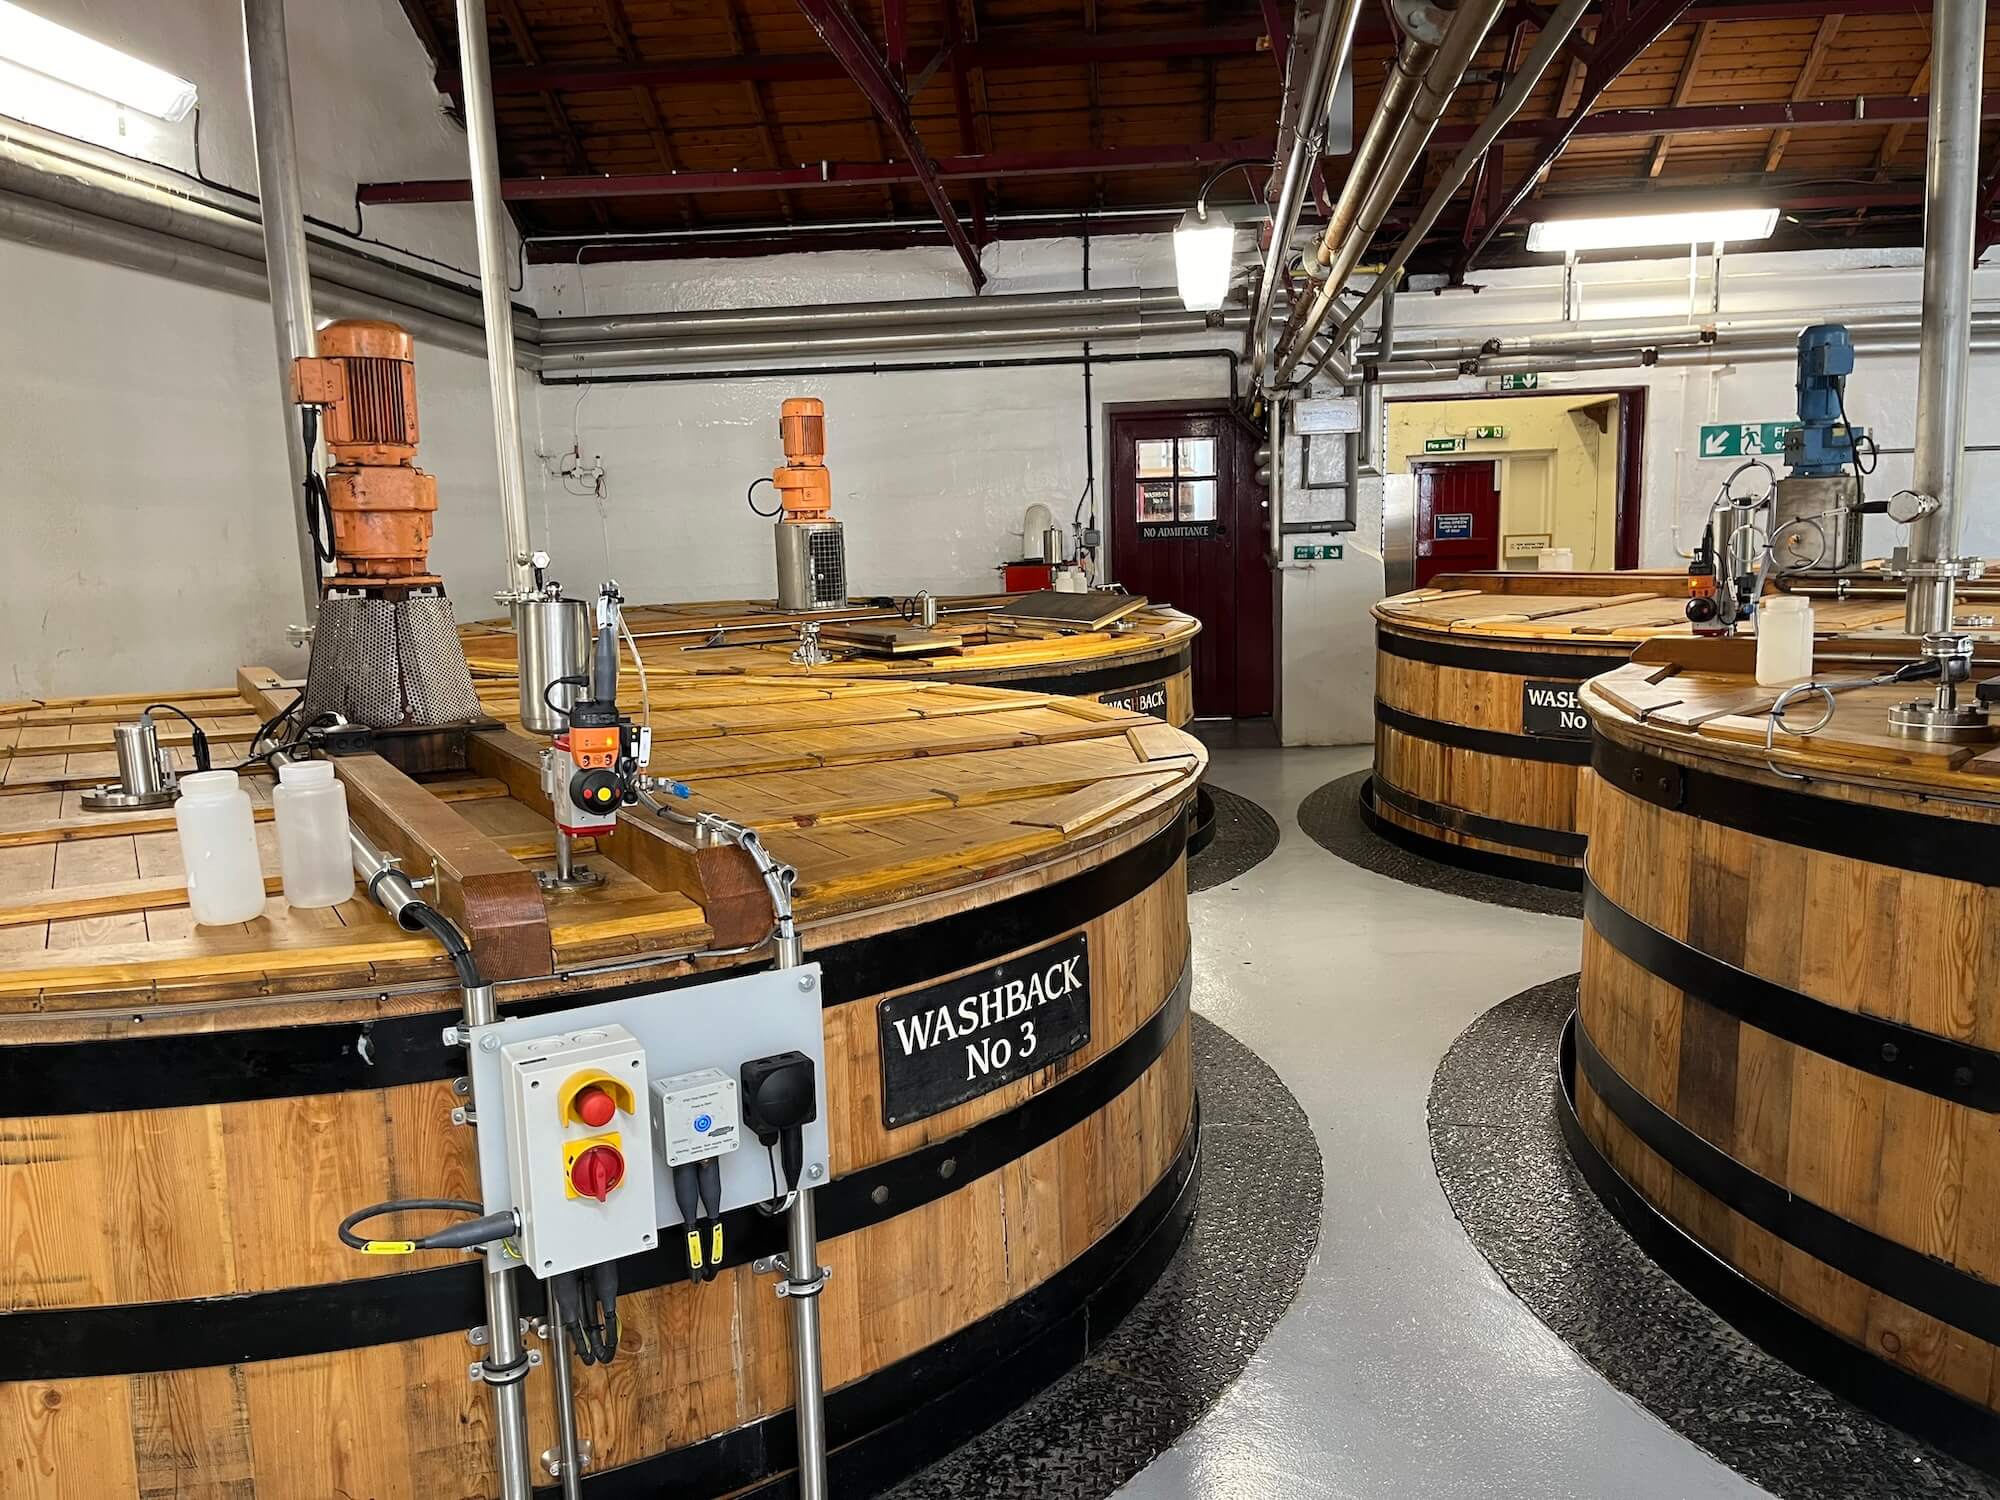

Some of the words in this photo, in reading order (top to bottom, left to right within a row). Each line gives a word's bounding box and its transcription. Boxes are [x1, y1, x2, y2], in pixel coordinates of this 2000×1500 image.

[1441, 441, 1454, 449] exit
[1143, 527, 1156, 538] NO
[1157, 526, 1209, 537] ADMITTANCE
[1528, 689, 1582, 709] WASH
[1560, 711, 1587, 729] No
[893, 955, 1083, 1056] WASHBACK
[965, 1037, 1012, 1081] No
[1019, 1021, 1037, 1058] 3
